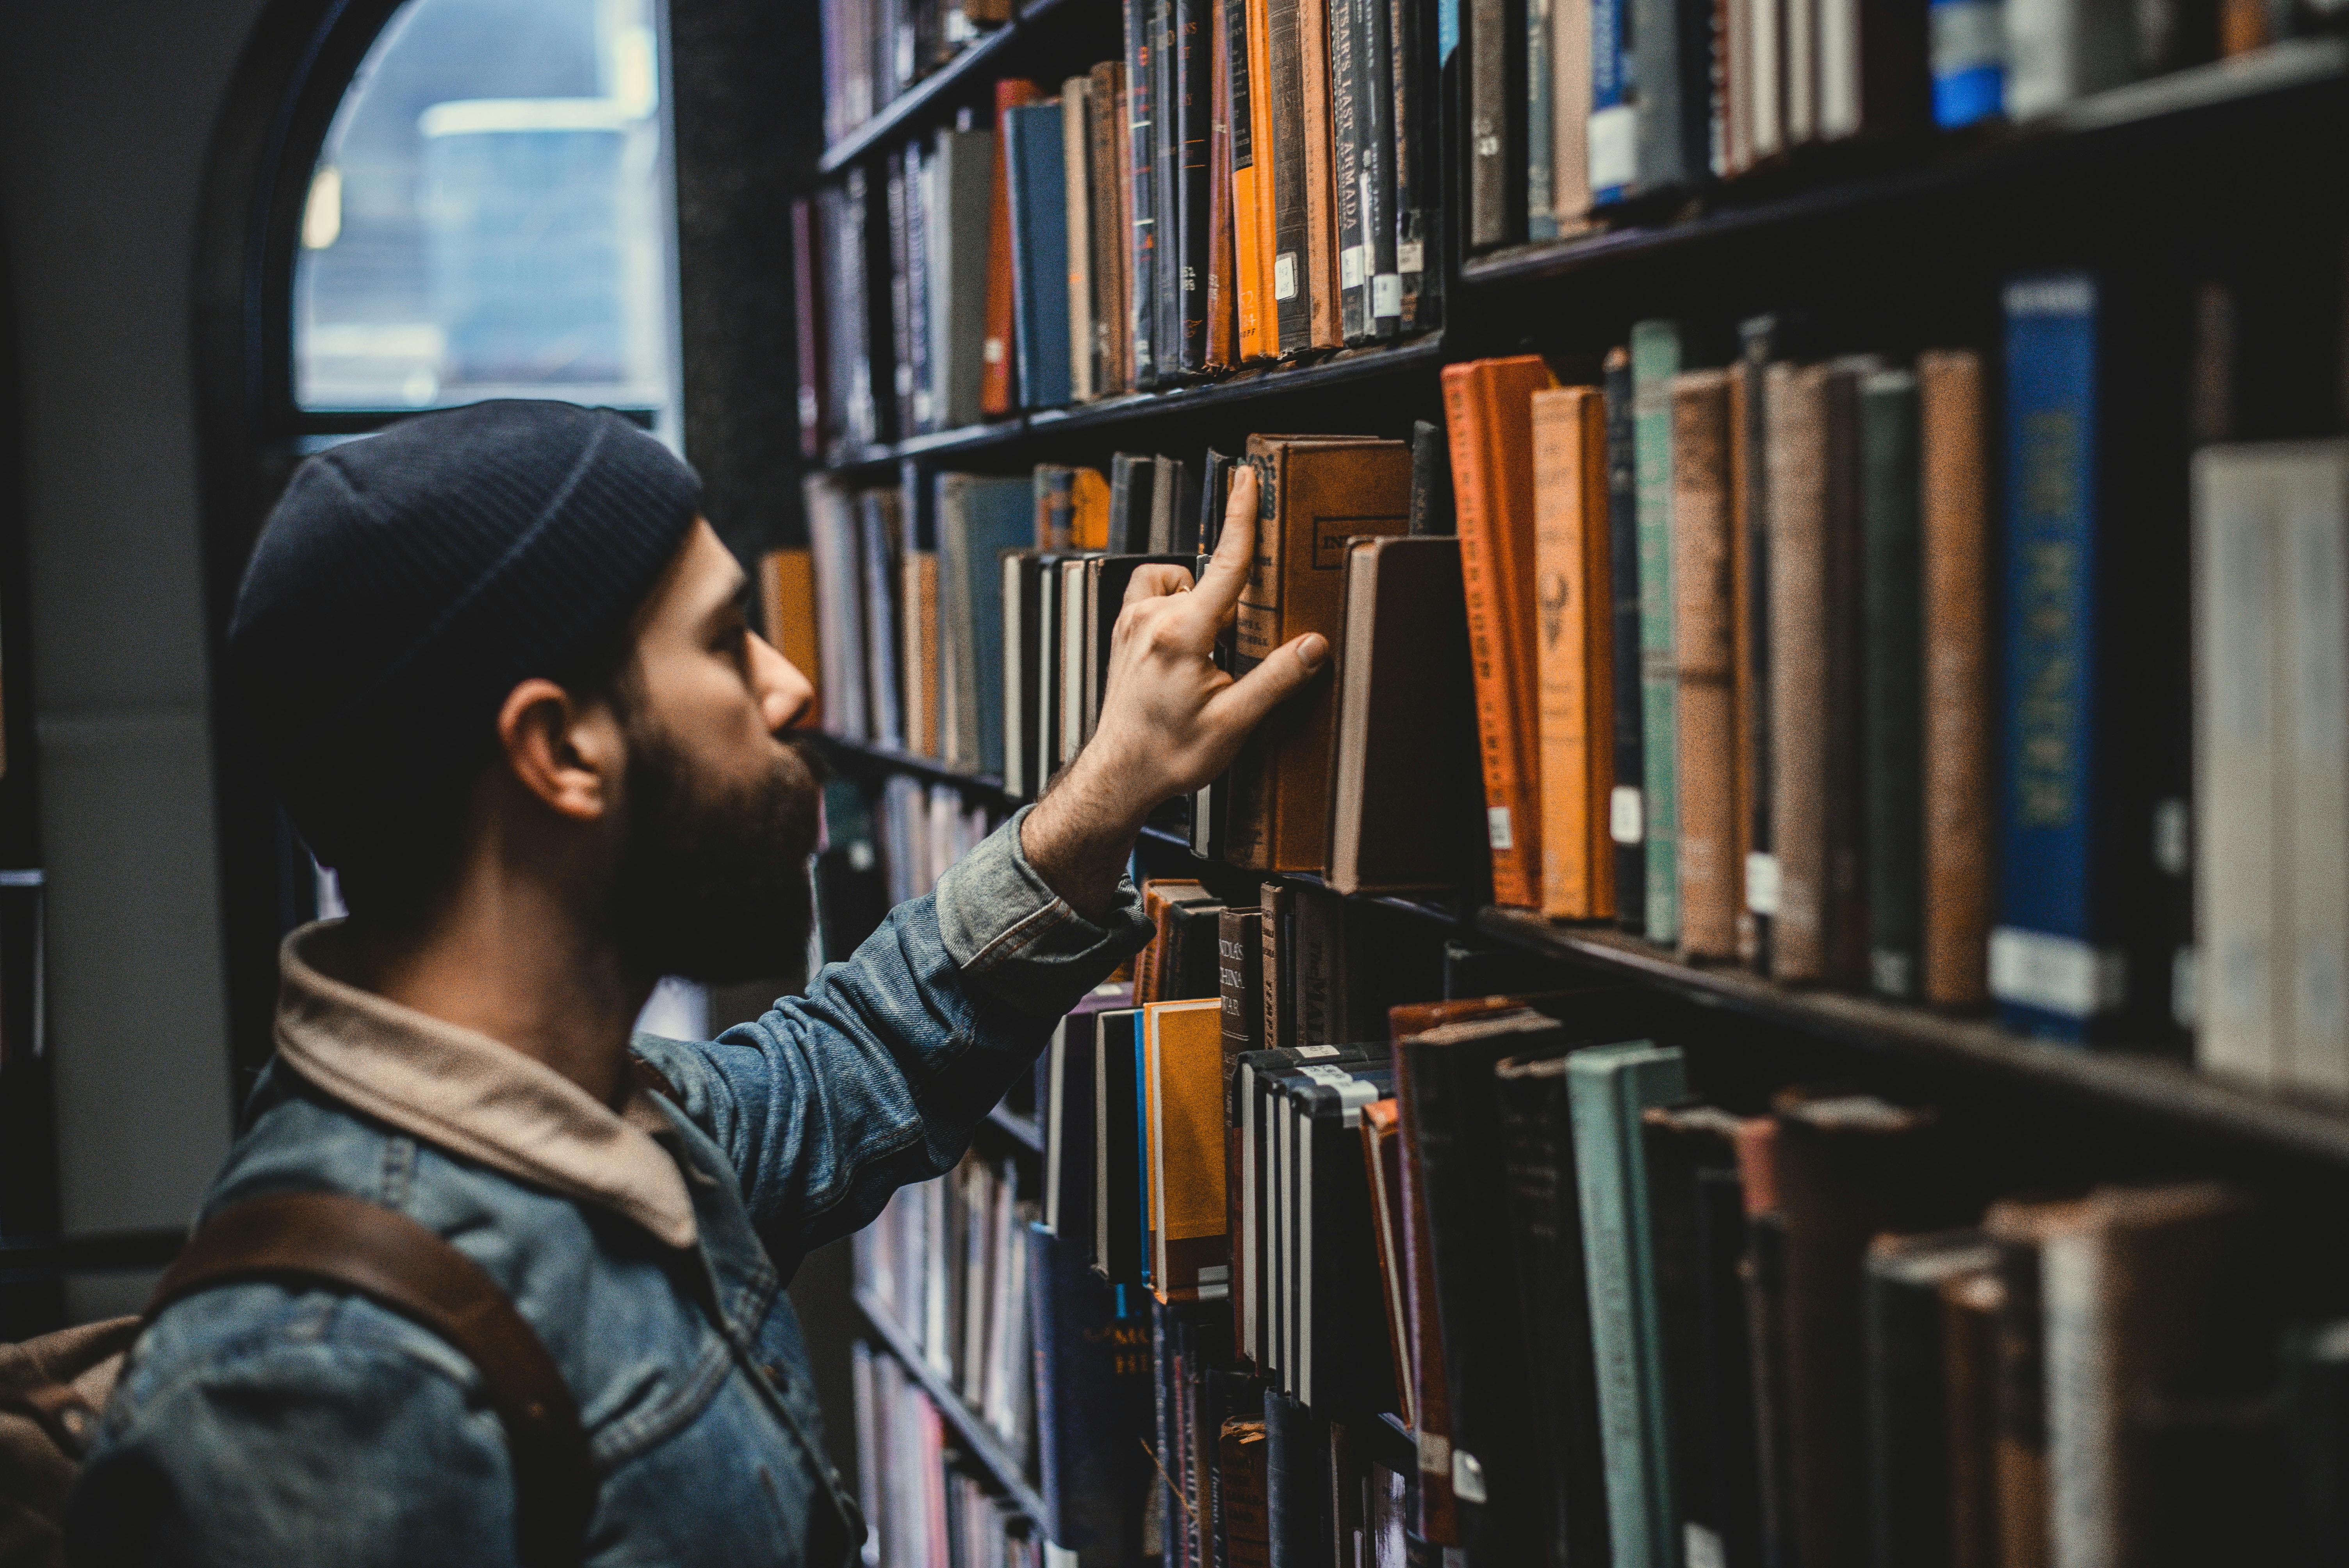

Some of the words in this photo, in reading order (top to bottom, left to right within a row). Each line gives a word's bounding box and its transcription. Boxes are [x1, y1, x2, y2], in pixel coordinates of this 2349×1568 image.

[1339, 2, 1351, 72] TSAR'S
[1341, 79, 1354, 129] LAST
[1344, 142, 1357, 229] ARMADA
[1219, 939, 1244, 960] NDIA'S
[1219, 966, 1245, 989] HINA
[1265, 980, 1274, 1050] TEMPTA
[1306, 976, 1325, 1045] MAL
